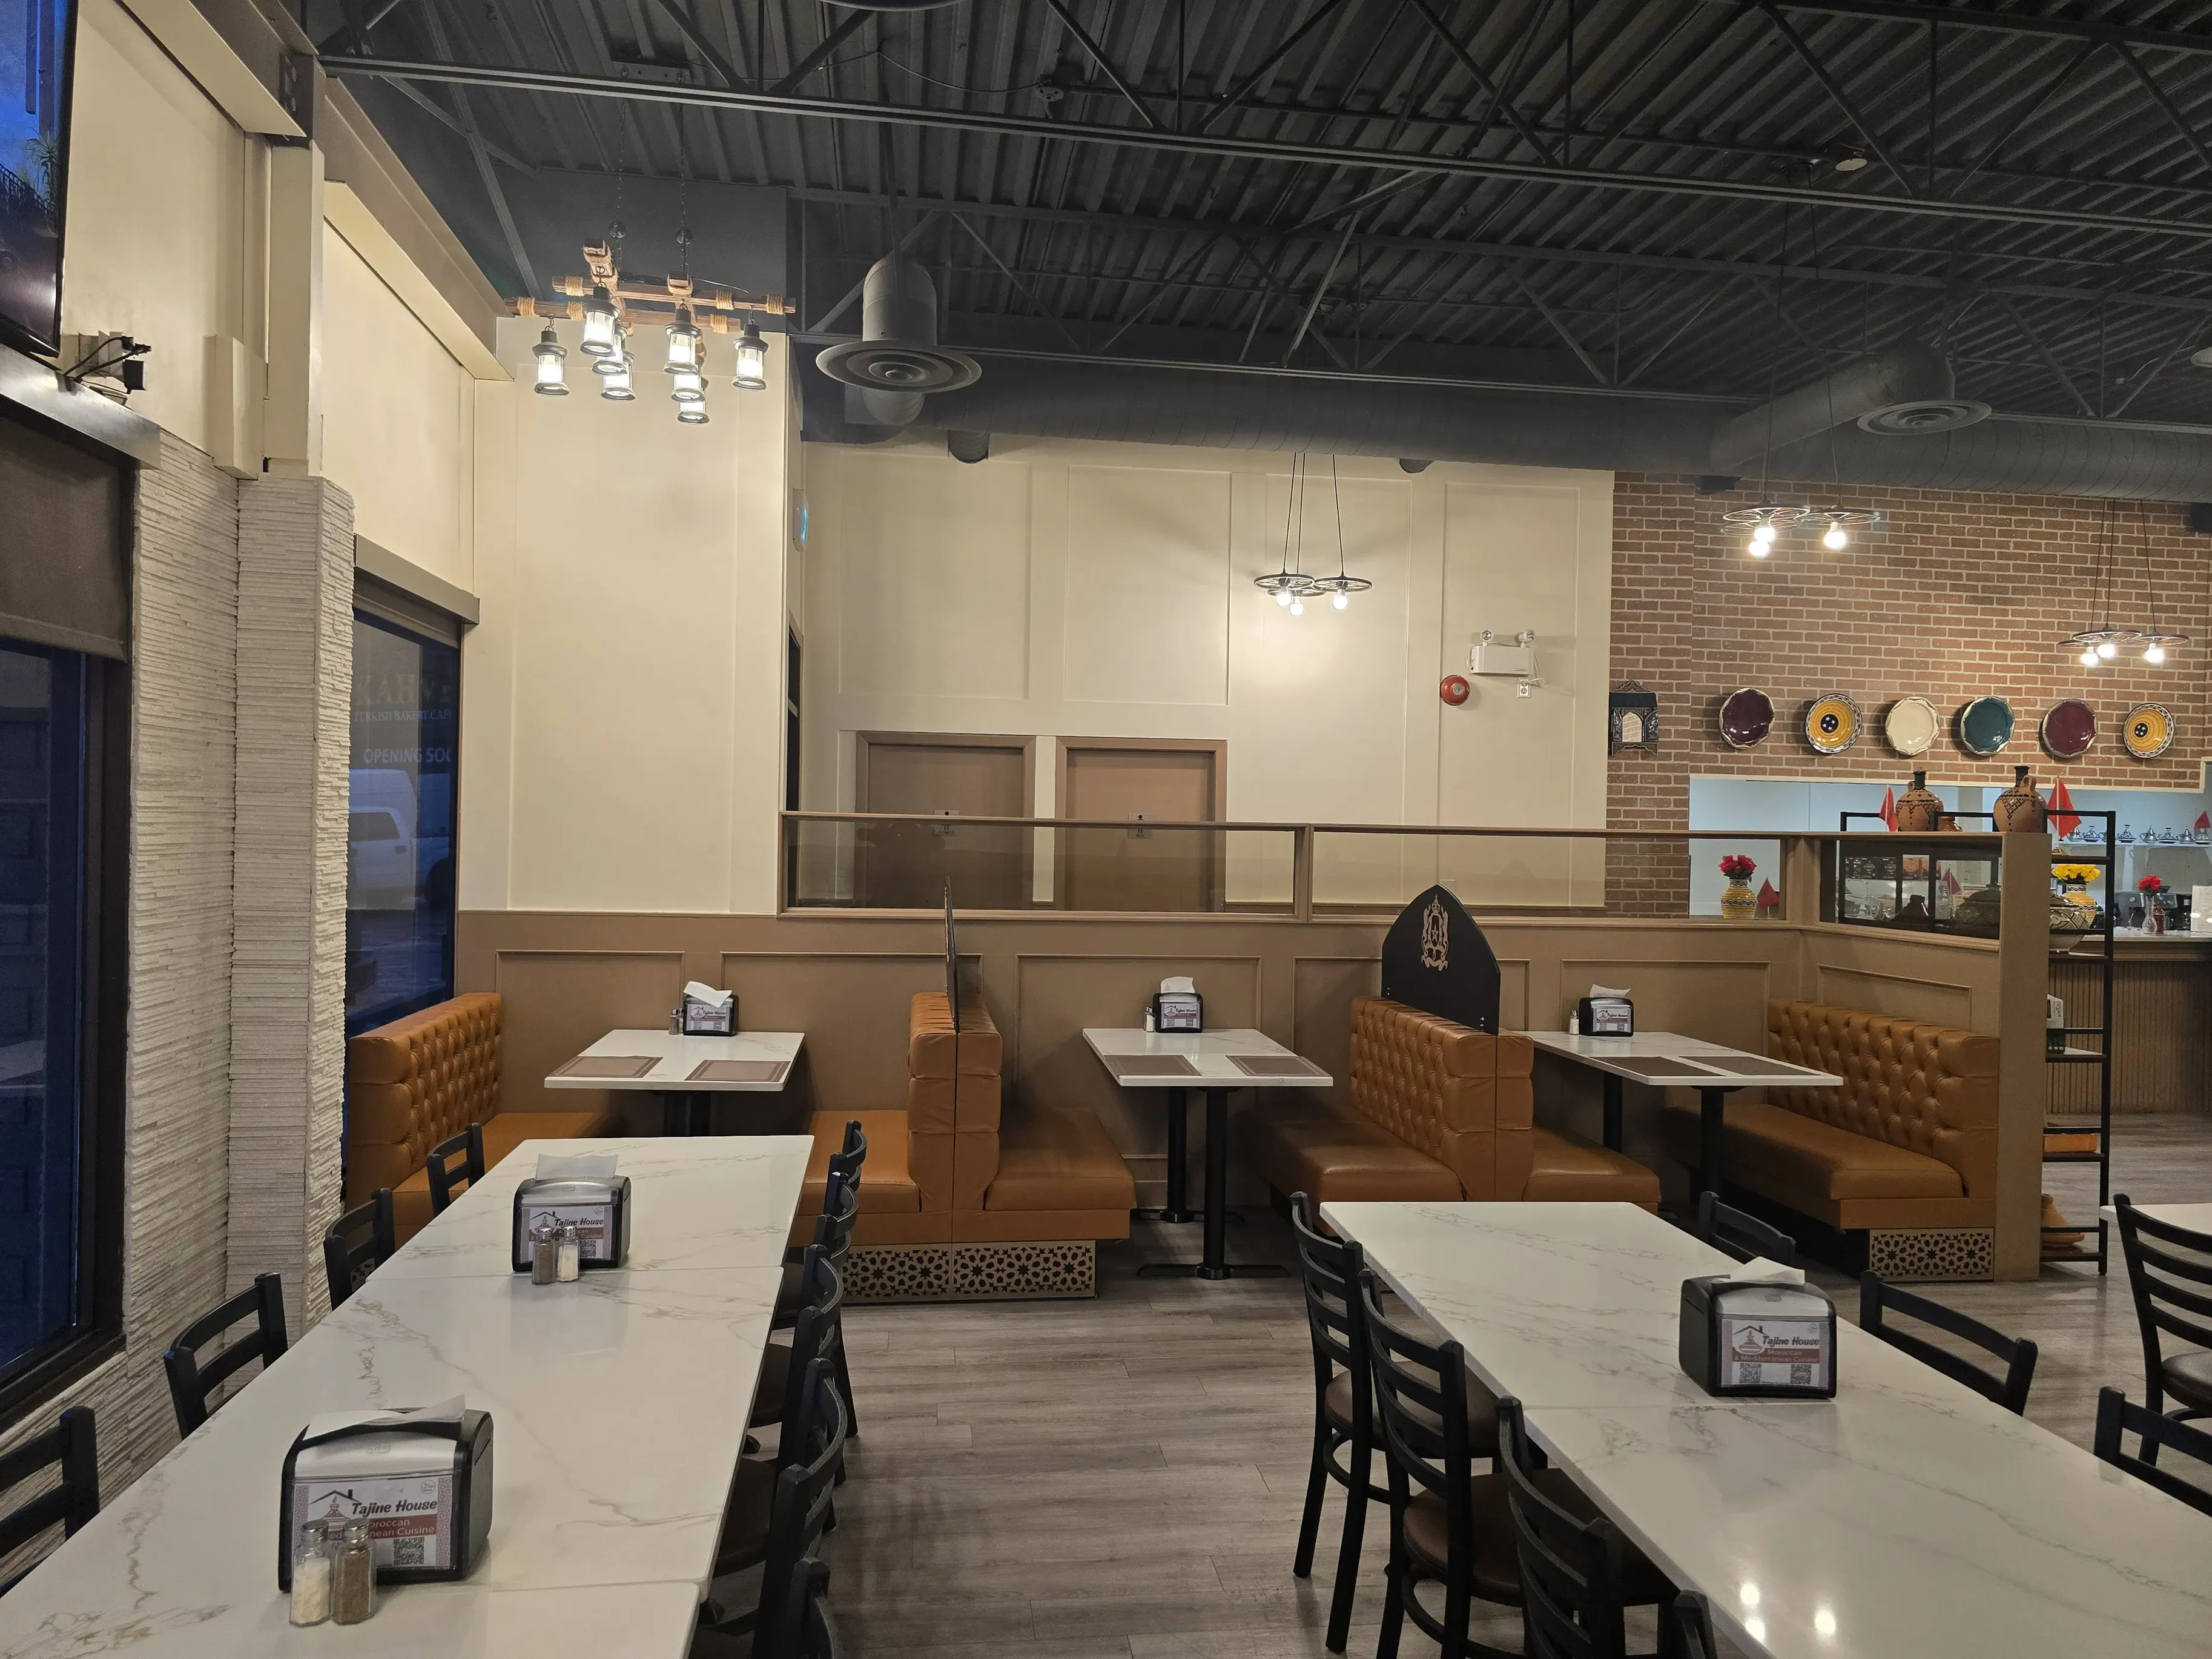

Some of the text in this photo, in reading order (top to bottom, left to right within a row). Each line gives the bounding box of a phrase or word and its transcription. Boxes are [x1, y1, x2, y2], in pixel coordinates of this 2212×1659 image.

[354, 710, 392, 722] TURKISH
[394, 710, 428, 722] BAKERY
[364, 747, 423, 764] OPENING
[555, 1218, 578, 1228] Tajine
[1762, 1336, 1820, 1347] Tajine House
[352, 1499, 437, 1517] Tajine House
[371, 1518, 410, 1528] oroccan
[397, 1526, 435, 1535] Cuisine
